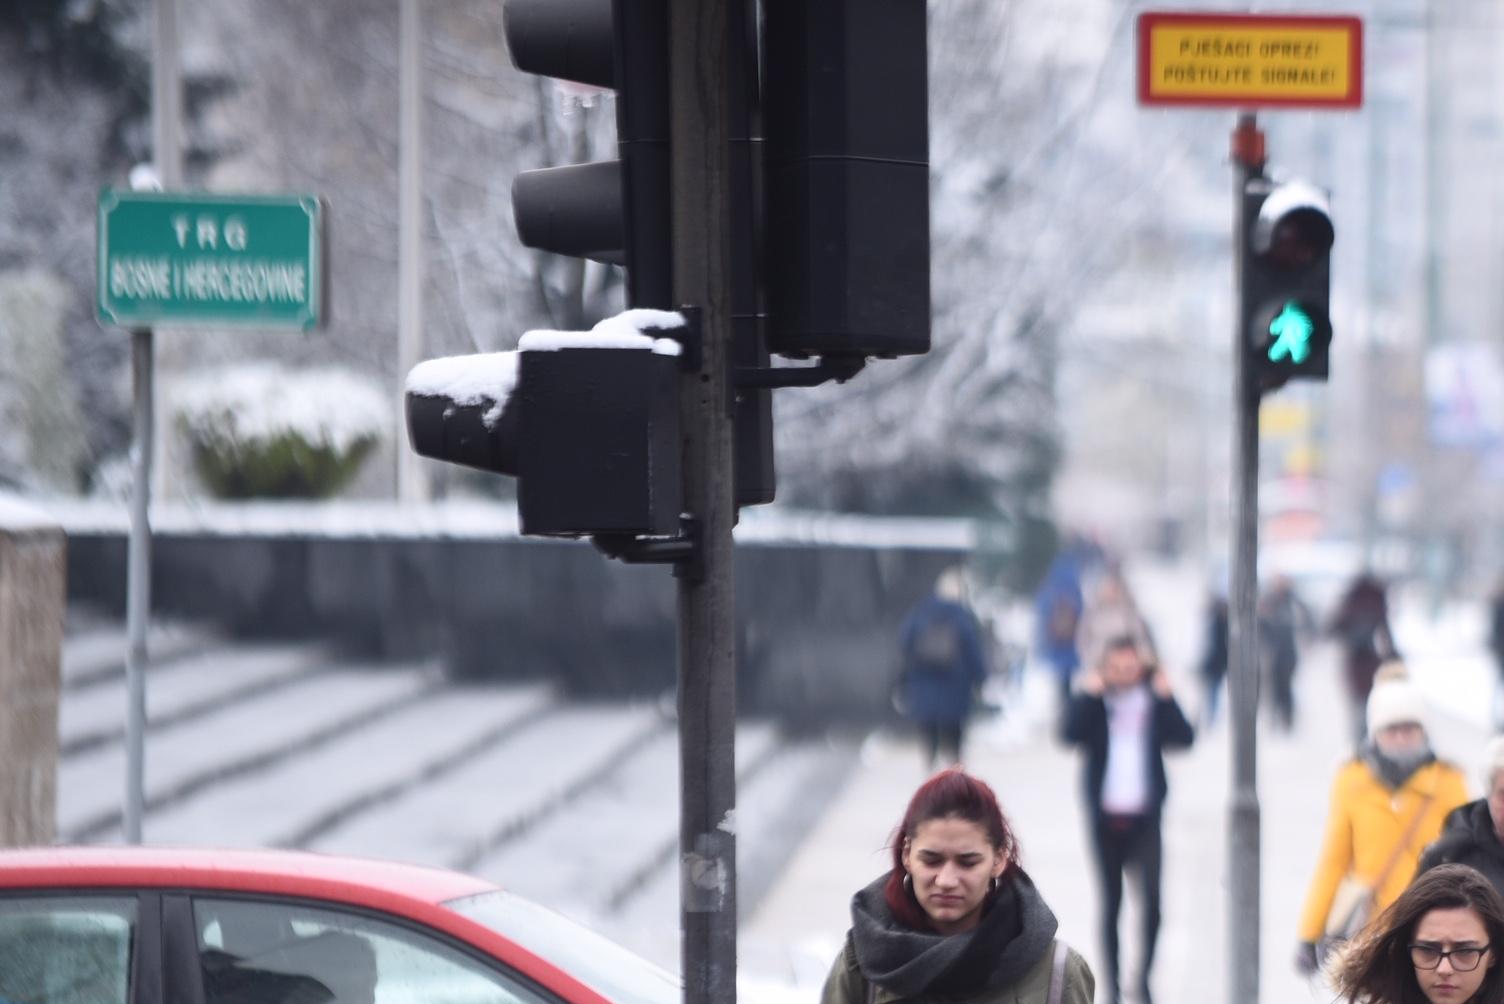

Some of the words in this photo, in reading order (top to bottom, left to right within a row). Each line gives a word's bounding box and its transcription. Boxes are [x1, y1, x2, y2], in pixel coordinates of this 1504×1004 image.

[172, 213, 248, 251] TRG
[111, 256, 170, 300] BOSNE
[184, 259, 305, 304] HERCEGOVINE
